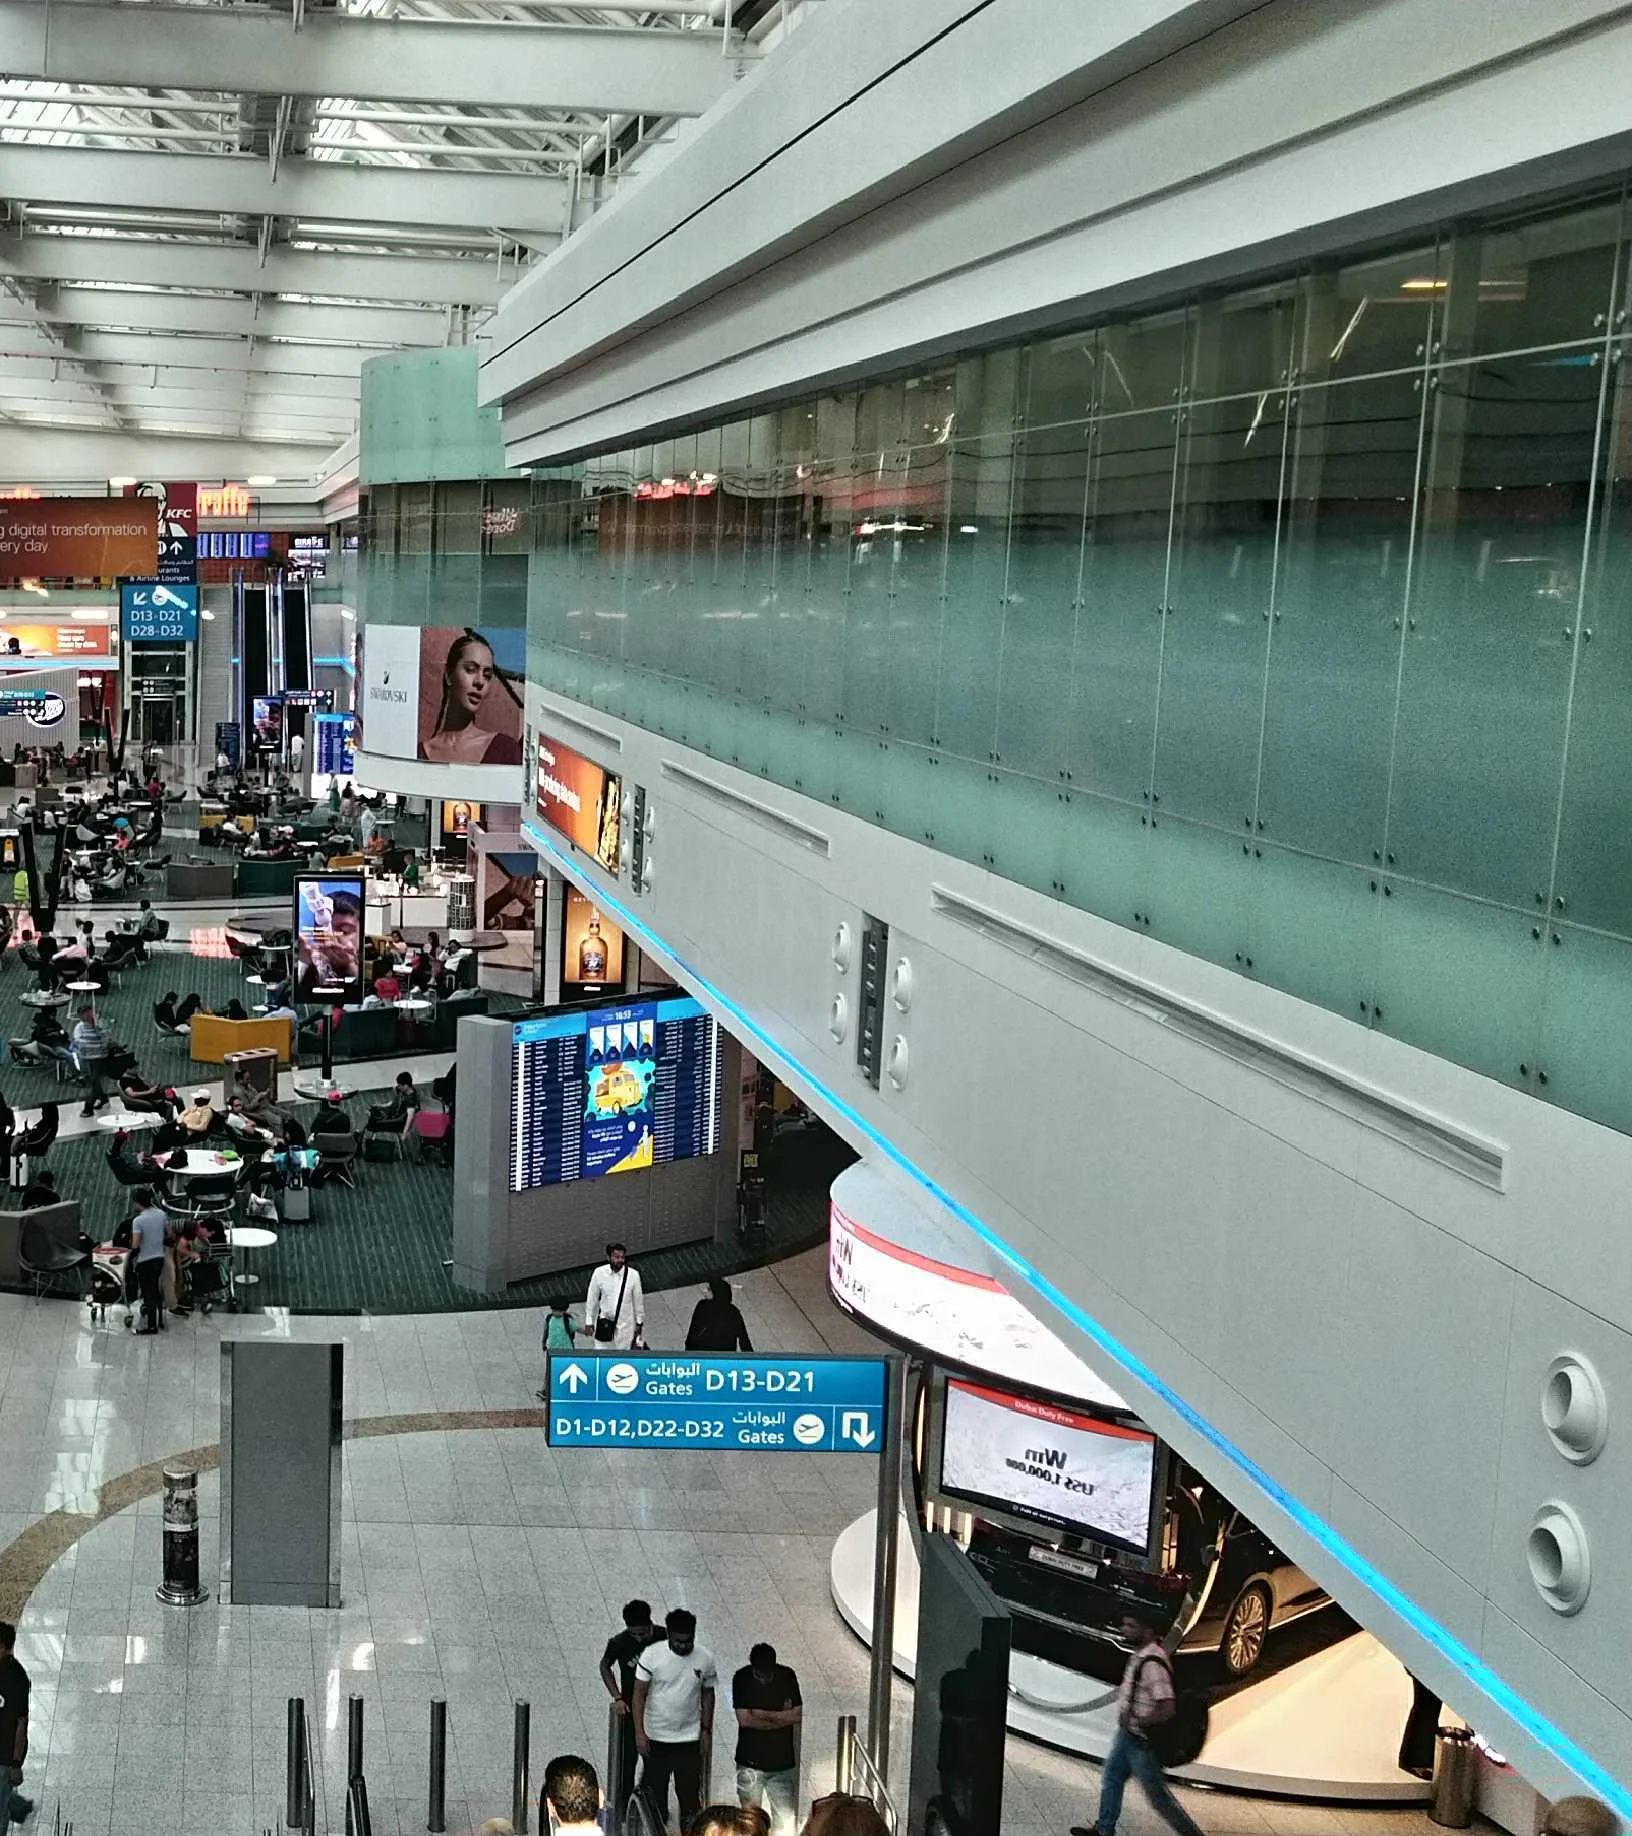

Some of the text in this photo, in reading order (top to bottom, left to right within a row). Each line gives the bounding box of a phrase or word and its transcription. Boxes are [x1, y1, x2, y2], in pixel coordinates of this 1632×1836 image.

[166, 509, 192, 518] KFC
[9, 523, 47, 539] digital
[52, 523, 147, 536] transformation
[161, 575, 190, 584] Lounges
[646, 1361, 700, 1378] البوابات
[646, 1370, 815, 1396] Gates D13-D21
[732, 1411, 786, 1427] البوابات
[1014, 1400, 1074, 1424] Dubai Duty Free
[556, 1419, 785, 1445] D1-D12,D22-D32 Gates
